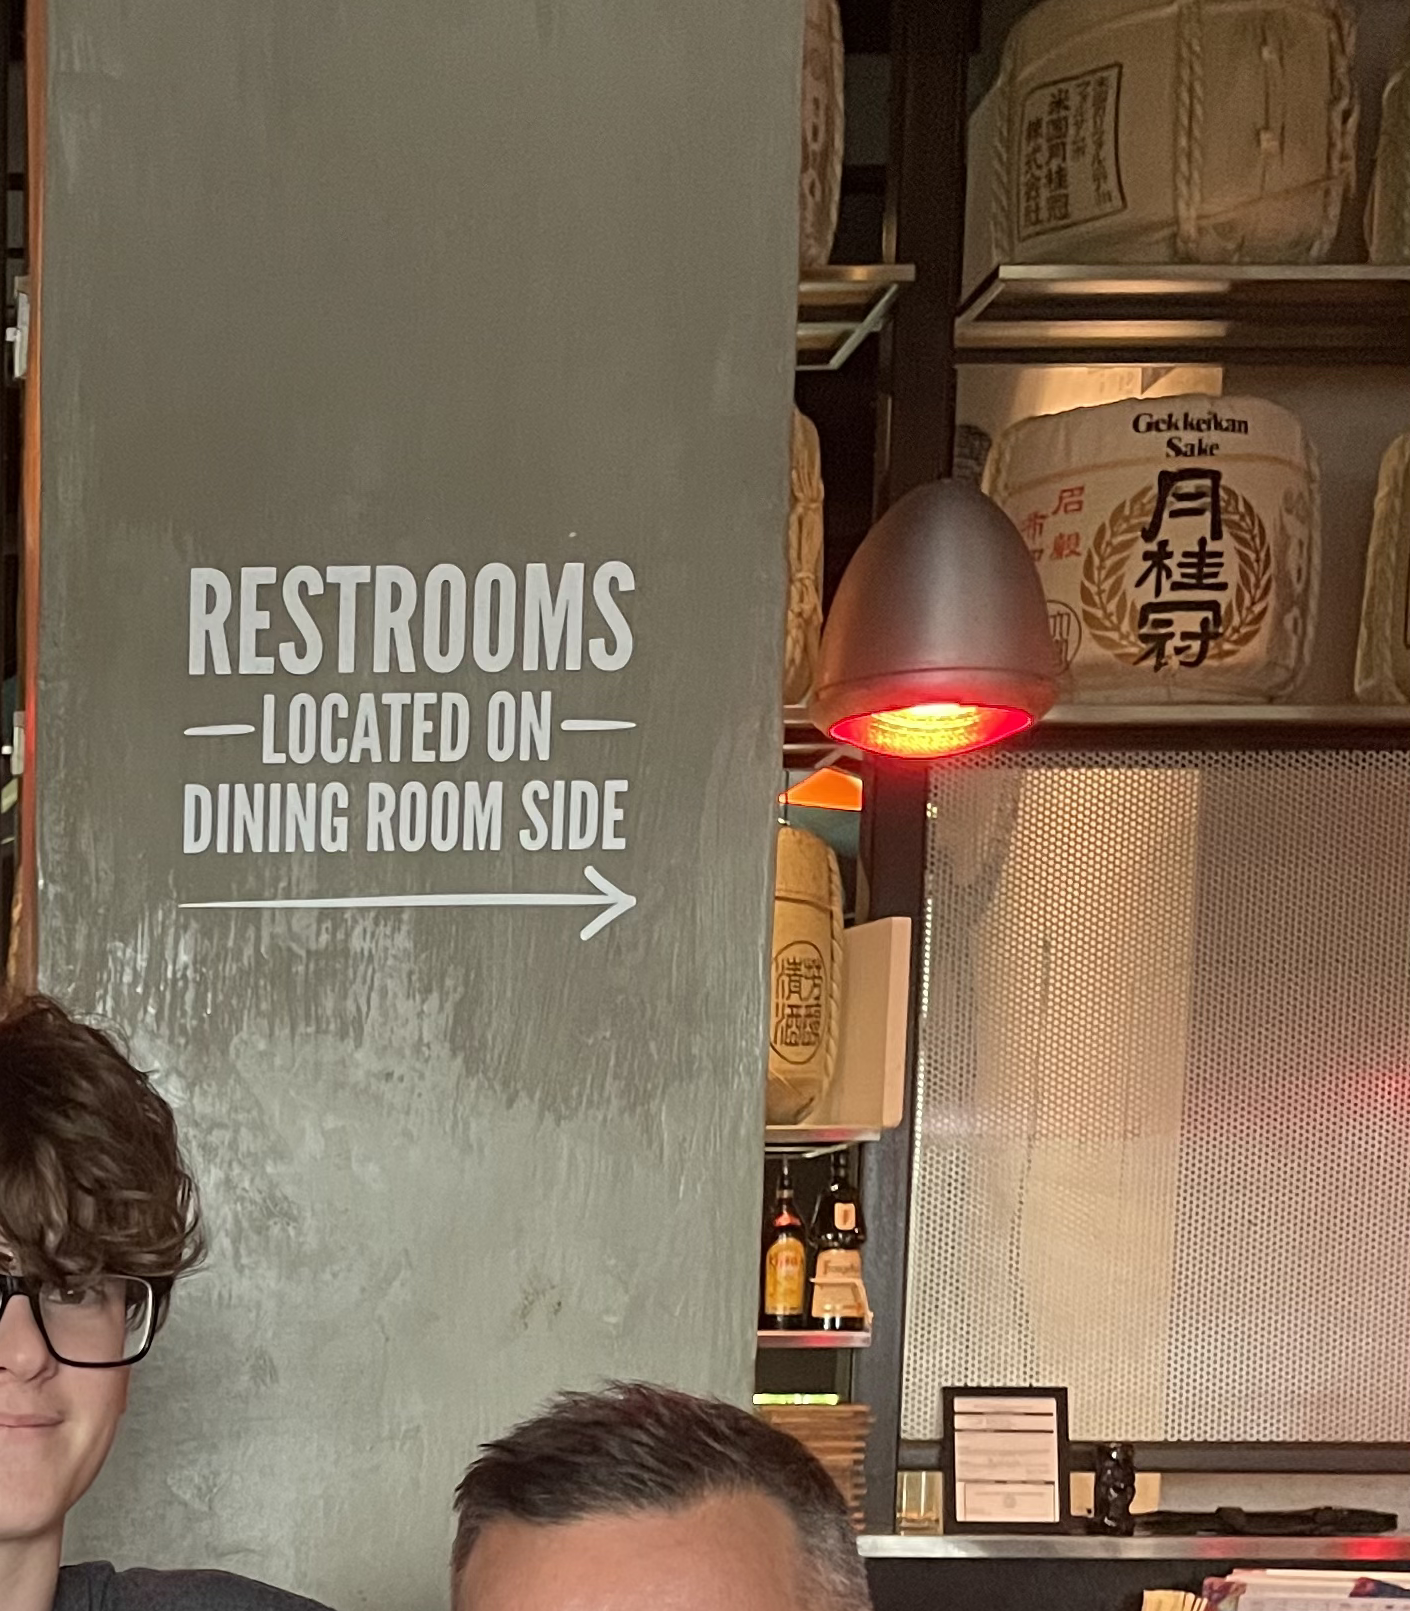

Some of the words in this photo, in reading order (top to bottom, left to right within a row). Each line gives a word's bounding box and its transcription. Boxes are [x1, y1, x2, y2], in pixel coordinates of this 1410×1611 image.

[1132, 412, 1248, 435] Gekkeikan
[1166, 436, 1219, 458] Sake
[1134, 467, 1228, 672] 月桂冠
[188, 561, 636, 675] RESTROOMS
[262, 692, 470, 764] LOCATED
[487, 691, 552, 762] ON
[183, 781, 349, 854] DINING
[366, 781, 503, 852] ROOM
[519, 779, 629, 851] SIDE
